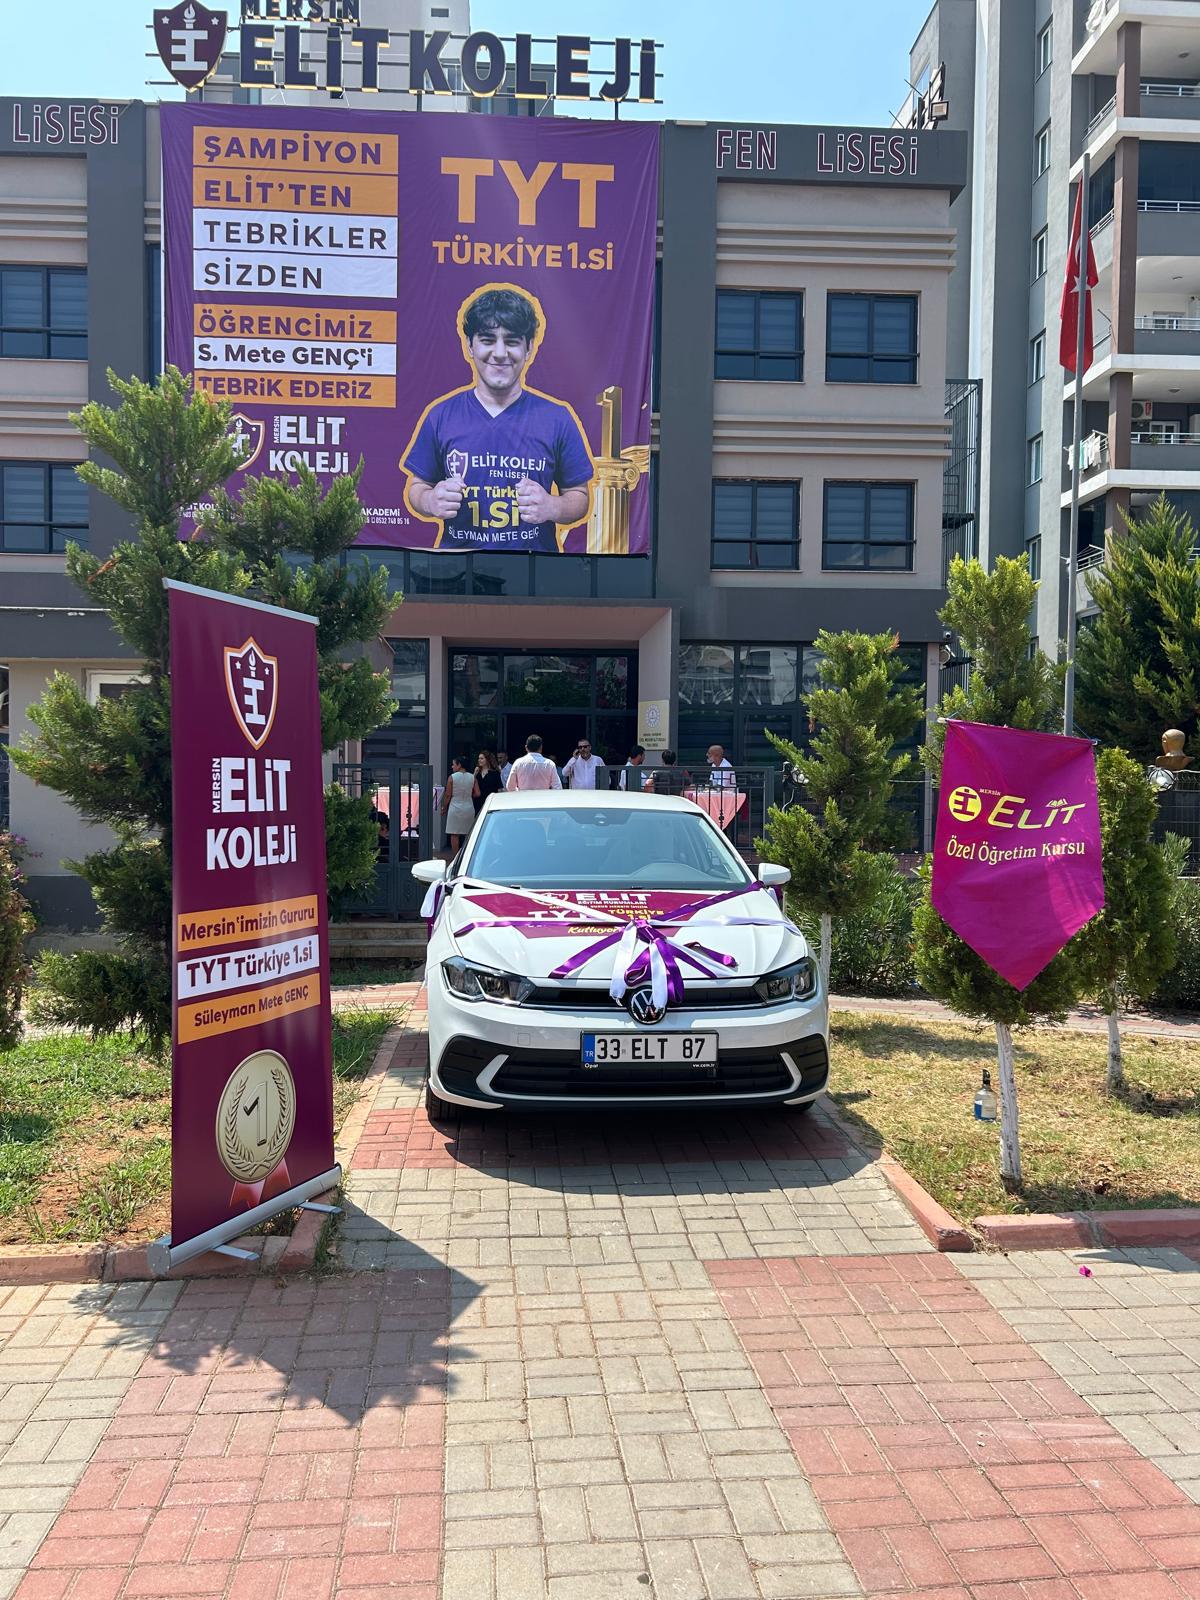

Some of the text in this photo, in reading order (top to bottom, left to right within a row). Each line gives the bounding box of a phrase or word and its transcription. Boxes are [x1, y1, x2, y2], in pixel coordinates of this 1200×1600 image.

[204, 133, 381, 164] ŞAMPİYON
[716, 129, 777, 170] FEN
[440, 156, 615, 228] TYT
[203, 218, 387, 250] TEBRİKLER
[432, 234, 562, 268] TÜRKİYE
[204, 257, 322, 289] SİZDEN
[199, 309, 373, 339] ÖĞRENCİMİZ
[198, 344, 218, 362] S.
[224, 344, 286, 364] Mete
[471, 451, 546, 472] ELİT KOLEJİ
[489, 469, 504, 478] FEN
[461, 486, 519, 498] YT Türki
[492, 531, 518, 543] METE
[946, 835, 1085, 865] Özel Öğretim Kursu
[280, 907, 315, 924] Gururu
[186, 940, 312, 988] TYT Türkiye 1.si
[194, 985, 309, 1027] Süleyman Mete GENÇ
[597, 1038, 620, 1060] 33
[632, 1038, 668, 1060] ELT
[682, 1038, 705, 1059] 87
